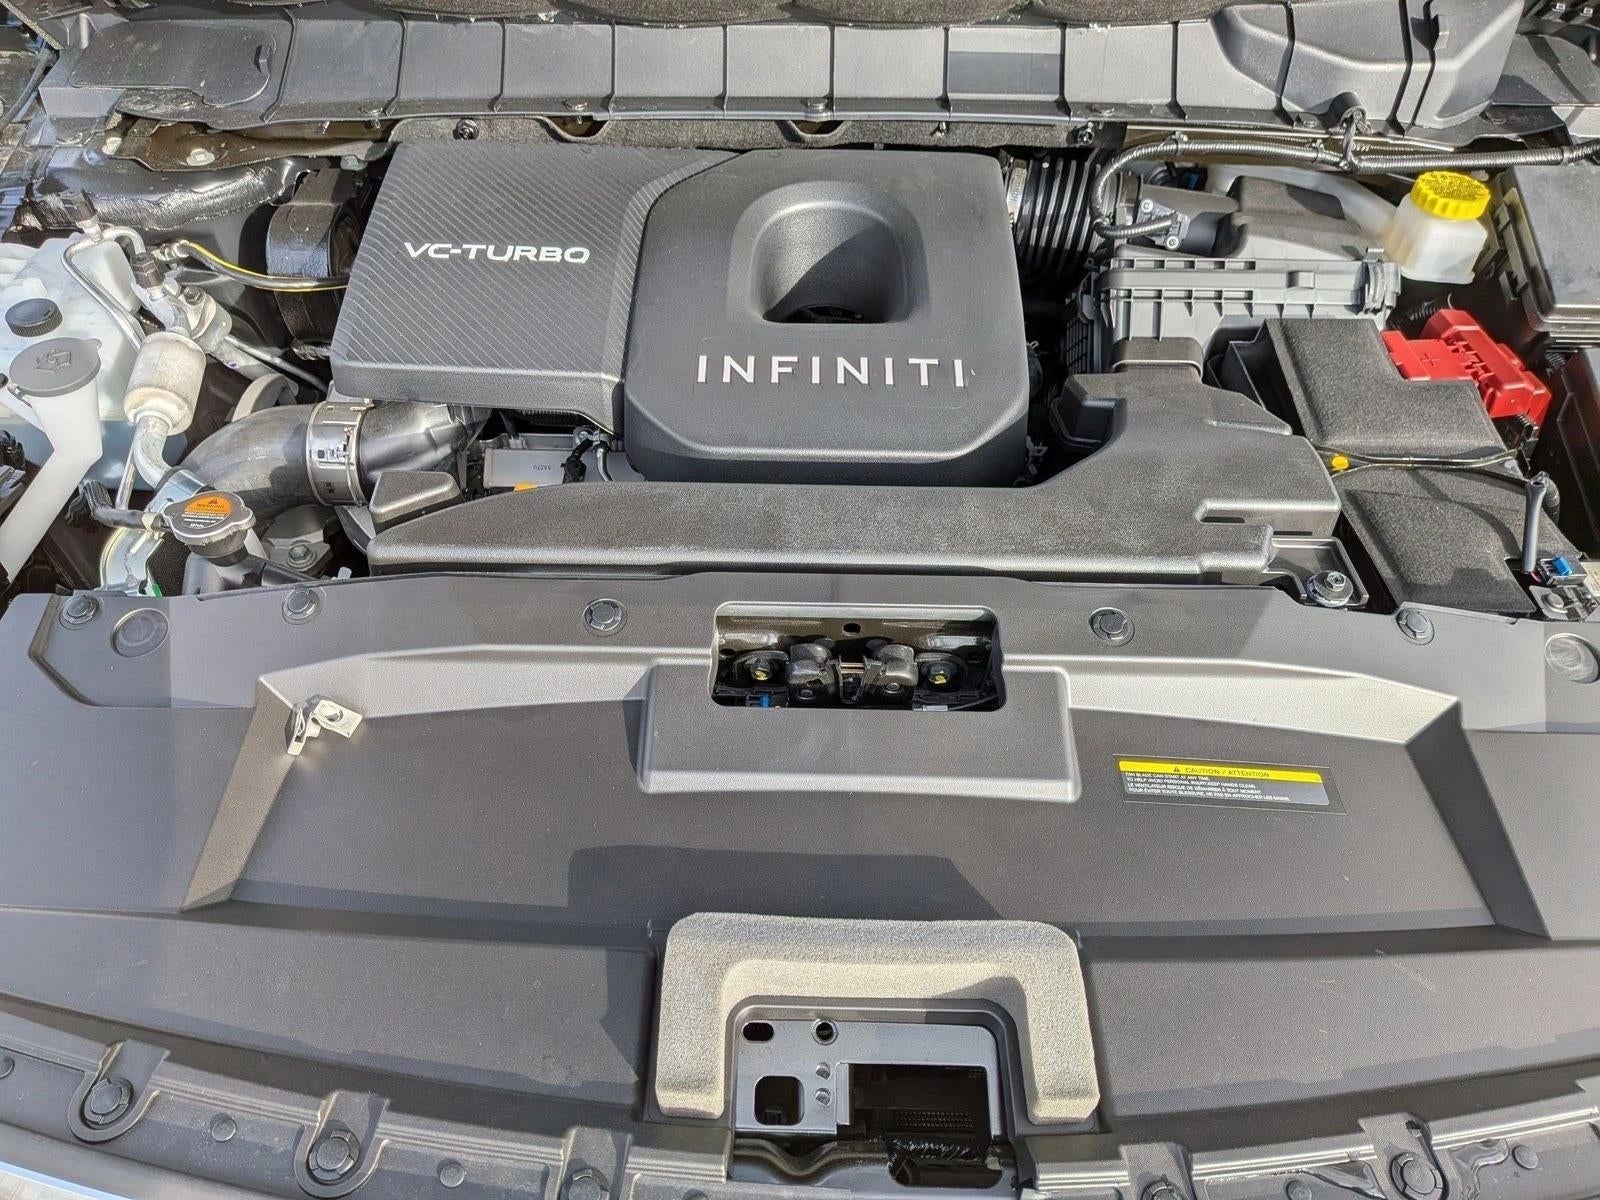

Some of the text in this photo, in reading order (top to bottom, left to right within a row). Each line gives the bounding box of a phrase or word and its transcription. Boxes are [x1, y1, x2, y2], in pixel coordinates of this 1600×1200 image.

[404, 242, 590, 264] VC-TURBO
[698, 355, 964, 387] INFINITI
[1185, 767, 1220, 775] CAUTION
[1228, 770, 1270, 778] ATTENTION
